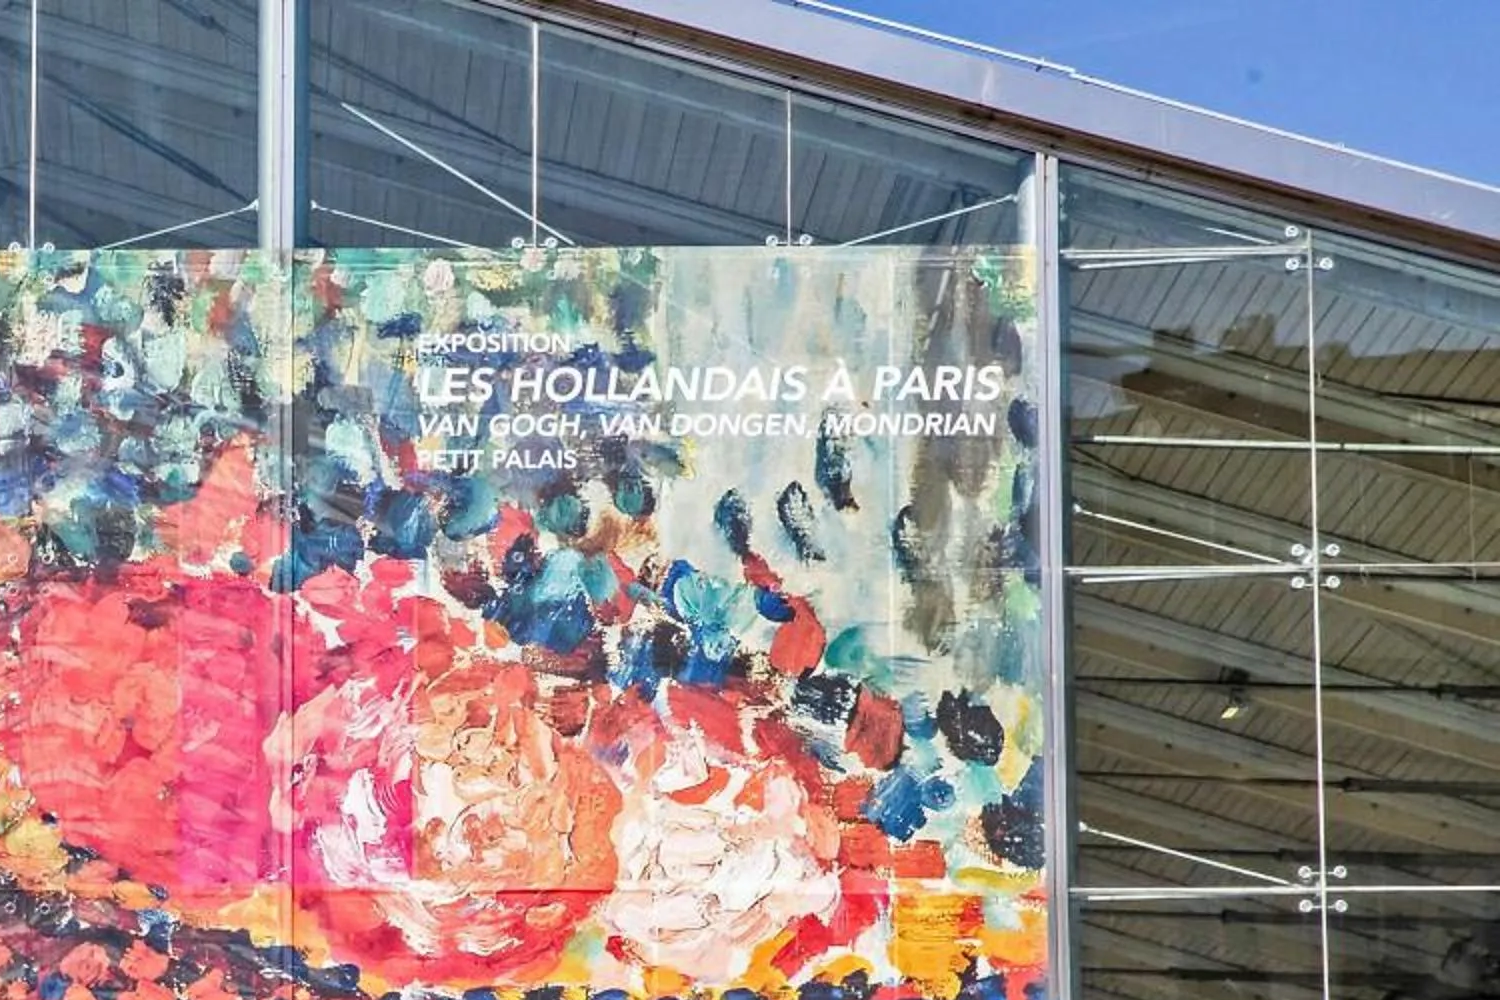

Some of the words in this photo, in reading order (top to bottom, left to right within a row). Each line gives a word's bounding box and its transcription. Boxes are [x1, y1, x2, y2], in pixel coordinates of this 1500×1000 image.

[418, 333, 571, 354] EXPOSITION
[419, 366, 494, 401] LES
[510, 365, 809, 401] HOLLANDAIS
[827, 357, 853, 401] À
[874, 364, 1004, 401] PARIS
[419, 414, 486, 436] VAN
[489, 413, 587, 440] GOGH,
[599, 414, 663, 436] VAN
[669, 413, 812, 439] DONGEN,
[825, 413, 998, 436] MONDRIAN
[417, 448, 485, 470] PETIT
[492, 448, 578, 470] PALAIS
